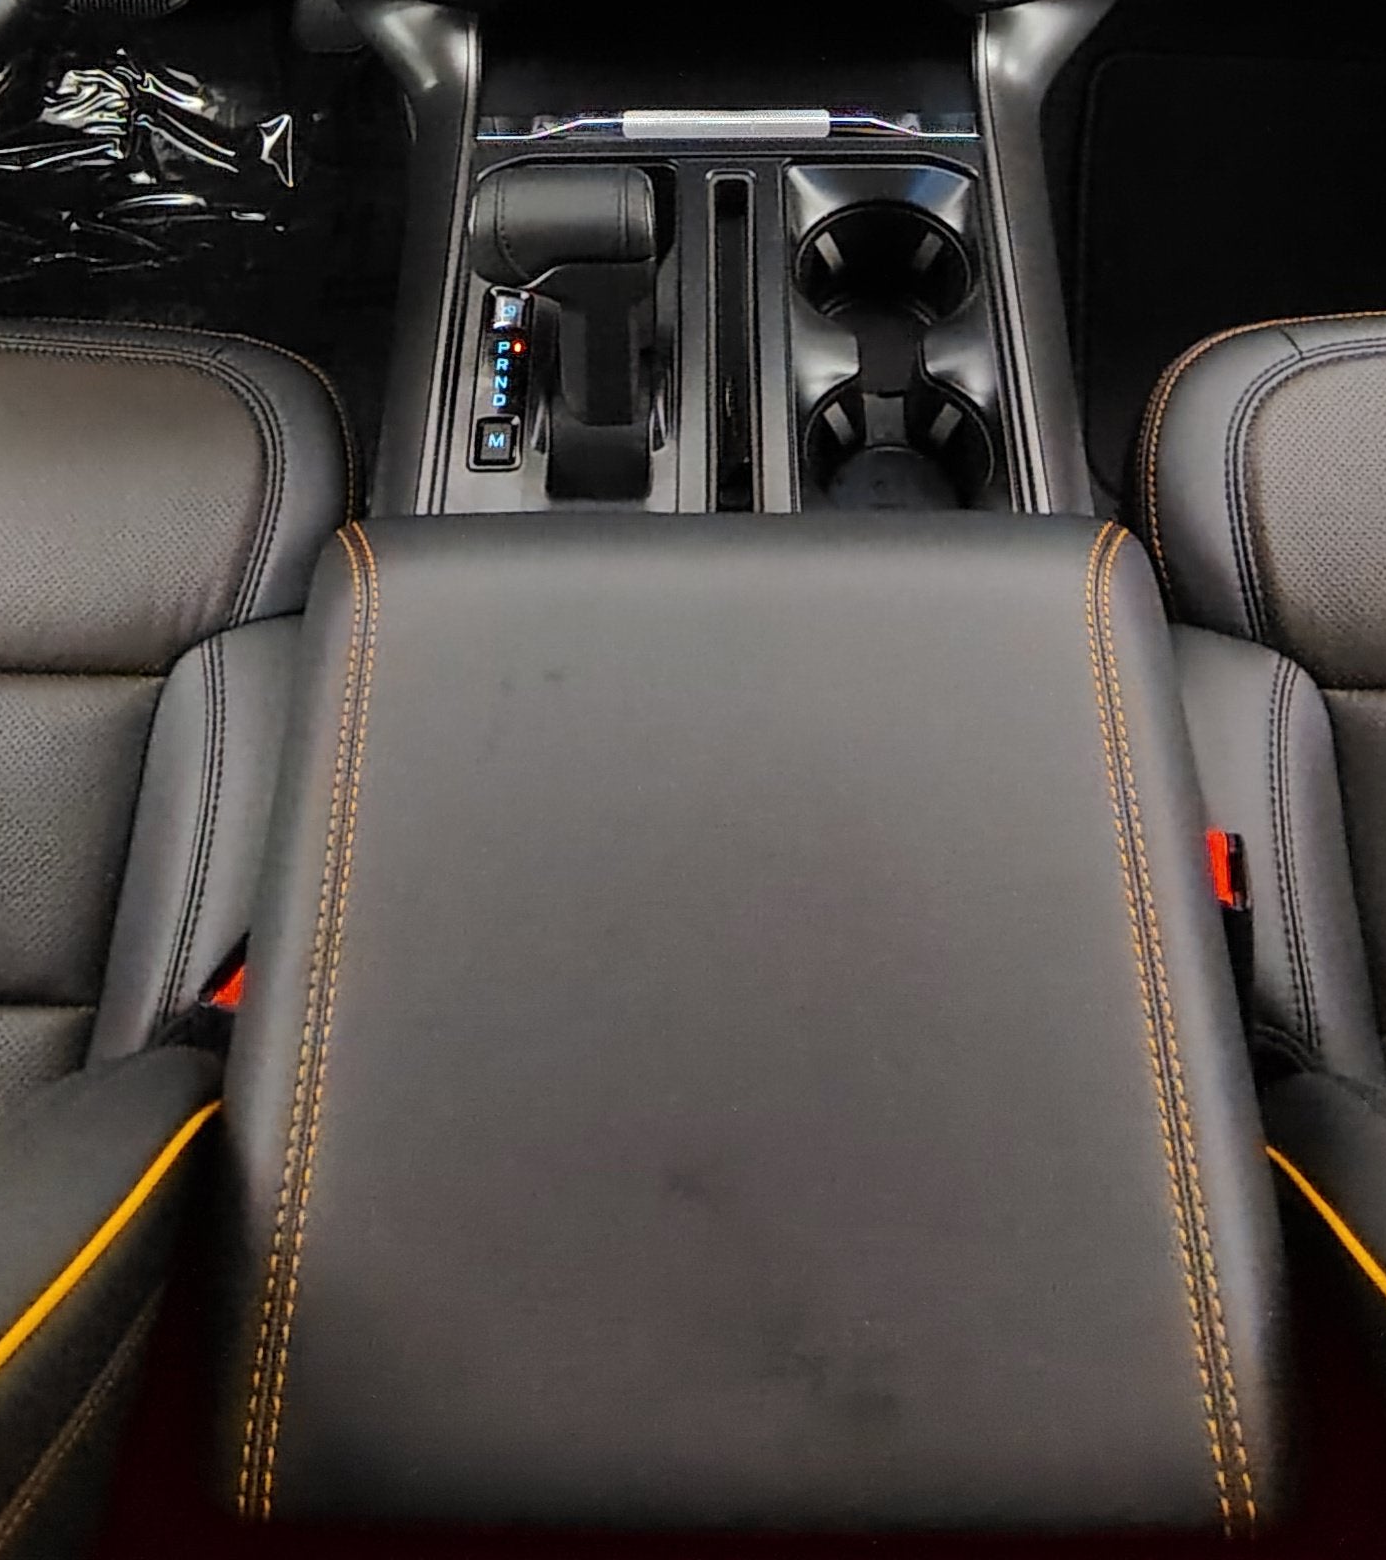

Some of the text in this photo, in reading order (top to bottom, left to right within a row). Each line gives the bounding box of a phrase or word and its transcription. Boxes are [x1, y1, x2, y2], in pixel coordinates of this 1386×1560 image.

[497, 341, 511, 353] P
[496, 358, 509, 371] R
[494, 376, 508, 389] N
[492, 393, 506, 407] D
[488, 433, 505, 448] M
